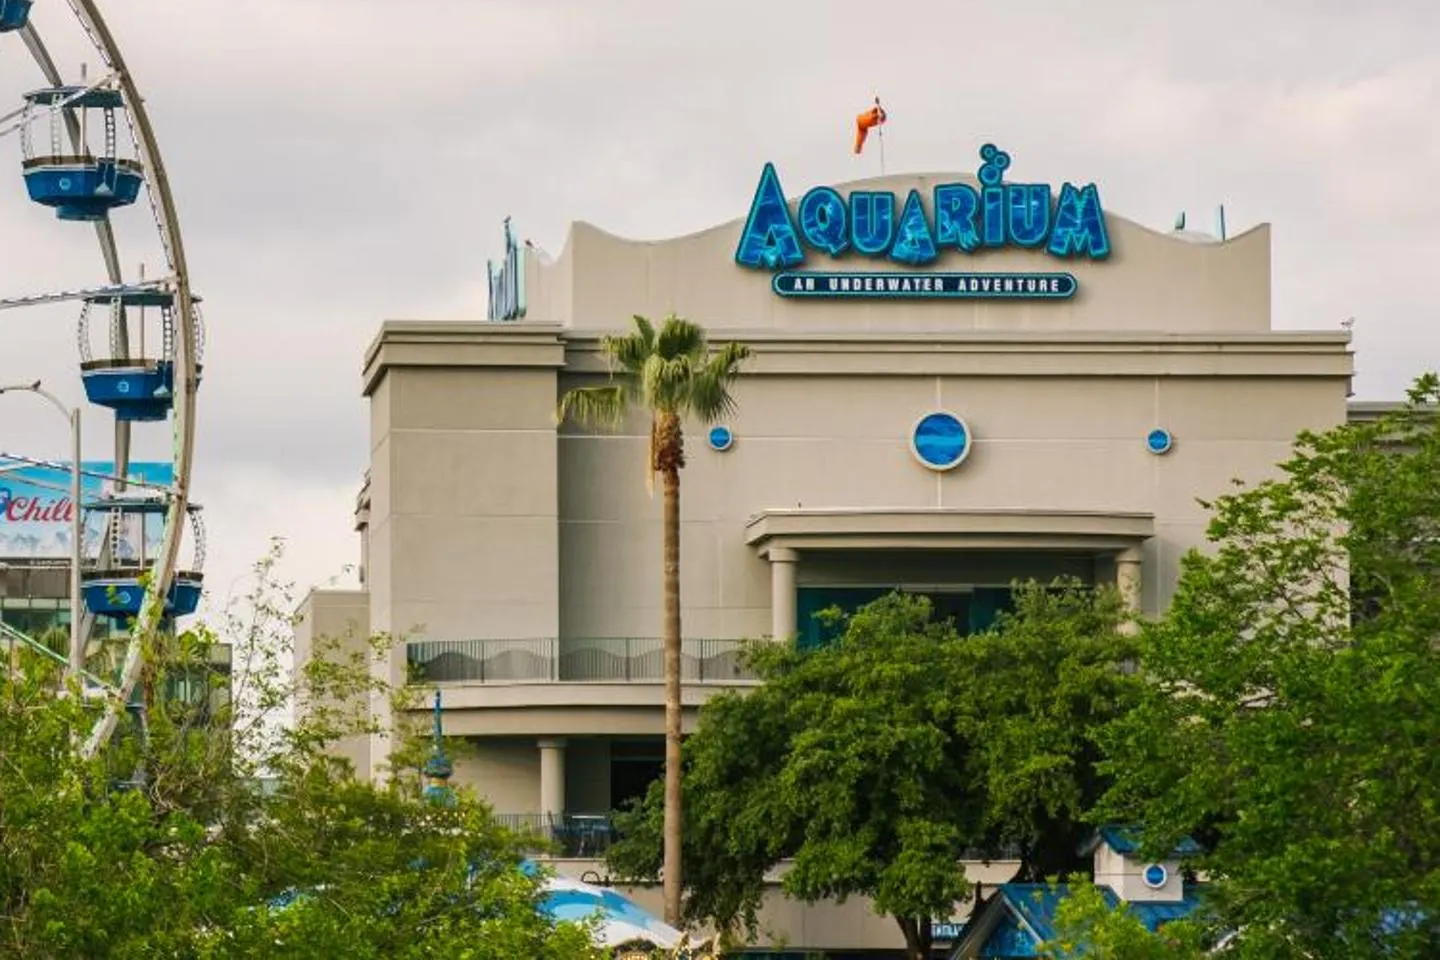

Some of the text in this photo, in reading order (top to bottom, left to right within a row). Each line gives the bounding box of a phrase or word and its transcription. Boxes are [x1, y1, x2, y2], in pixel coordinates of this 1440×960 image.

[793, 279, 1059, 291] AN UNDERWATER ADVENTURE
[7, 496, 73, 521] Chill
